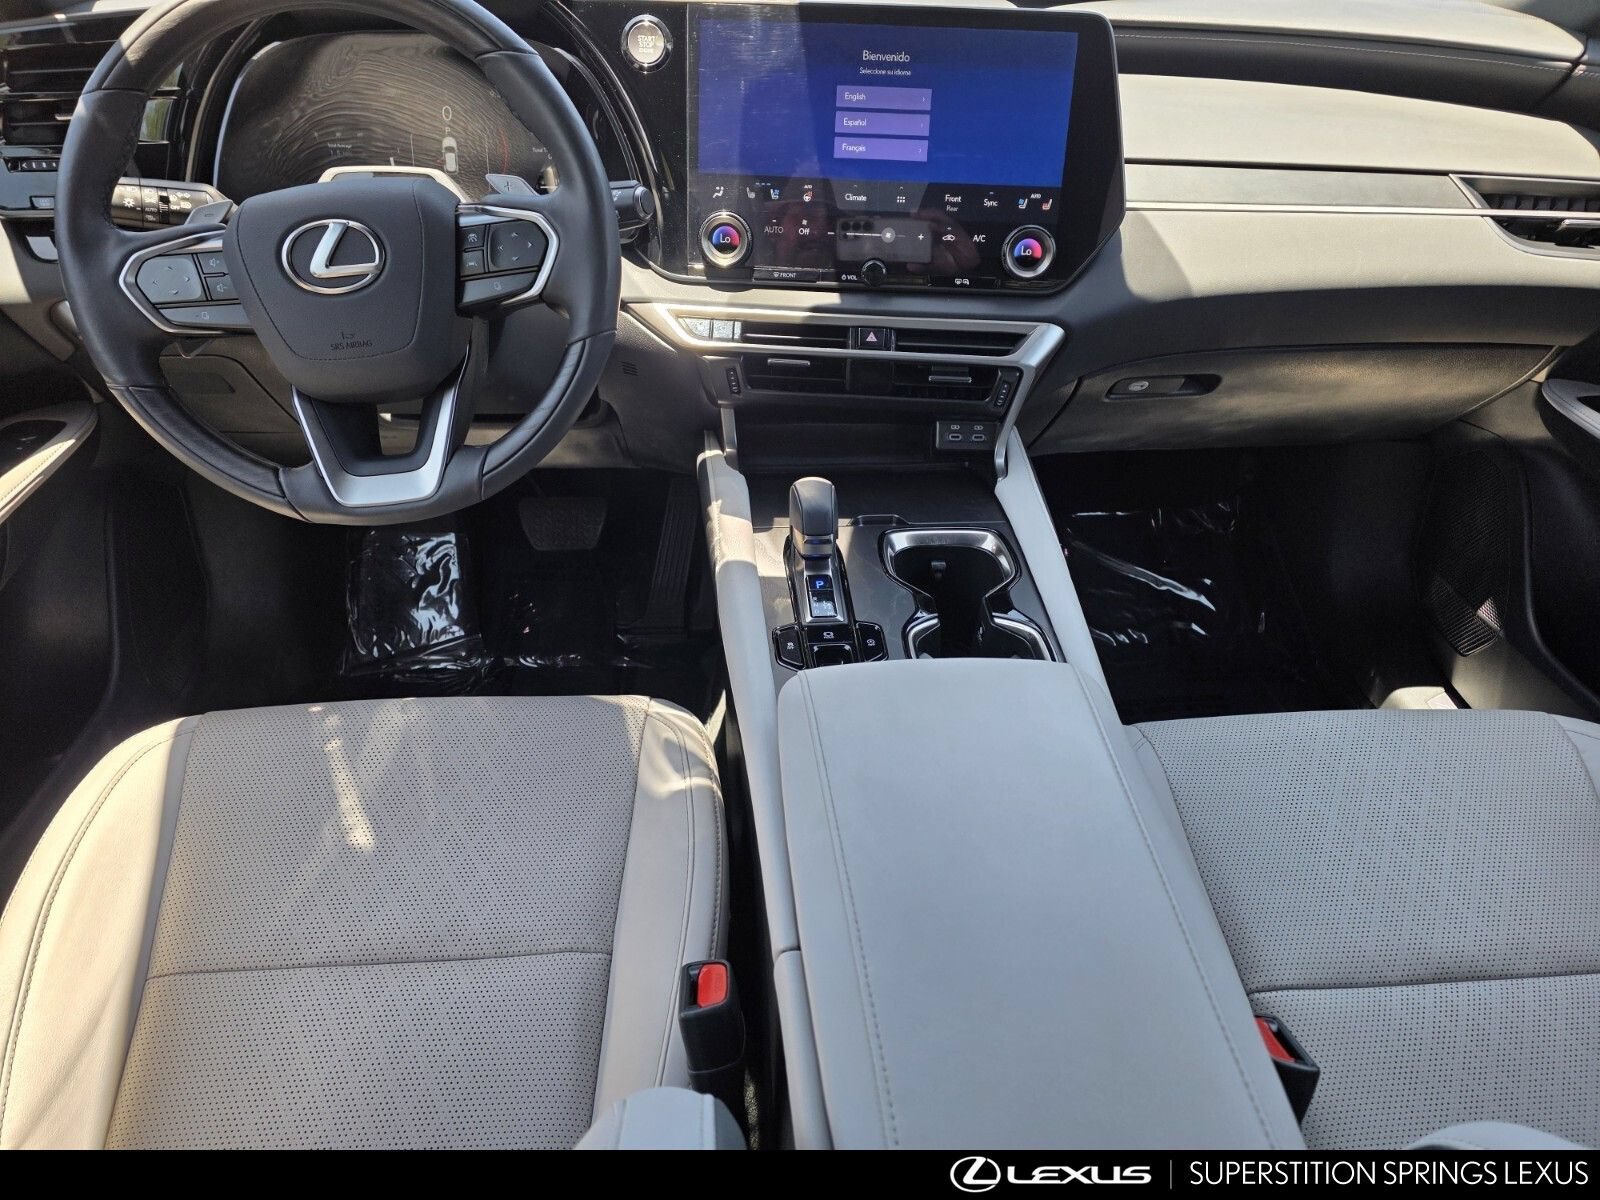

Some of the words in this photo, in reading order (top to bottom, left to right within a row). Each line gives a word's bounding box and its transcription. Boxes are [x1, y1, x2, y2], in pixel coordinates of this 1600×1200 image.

[862, 49, 910, 62] Bienvenido
[893, 68, 911, 76] idioma
[844, 91, 866, 102] English
[843, 117, 867, 126] Español
[842, 142, 866, 152] Français
[844, 193, 867, 201] Climate
[945, 194, 962, 203] Front
[983, 198, 998, 207] Sync
[764, 226, 784, 234] AUTO
[798, 227, 810, 235] Off
[720, 233, 731, 244] Lo
[972, 234, 986, 243] A/C
[1020, 246, 1032, 256] Lo
[815, 581, 824, 589] P
